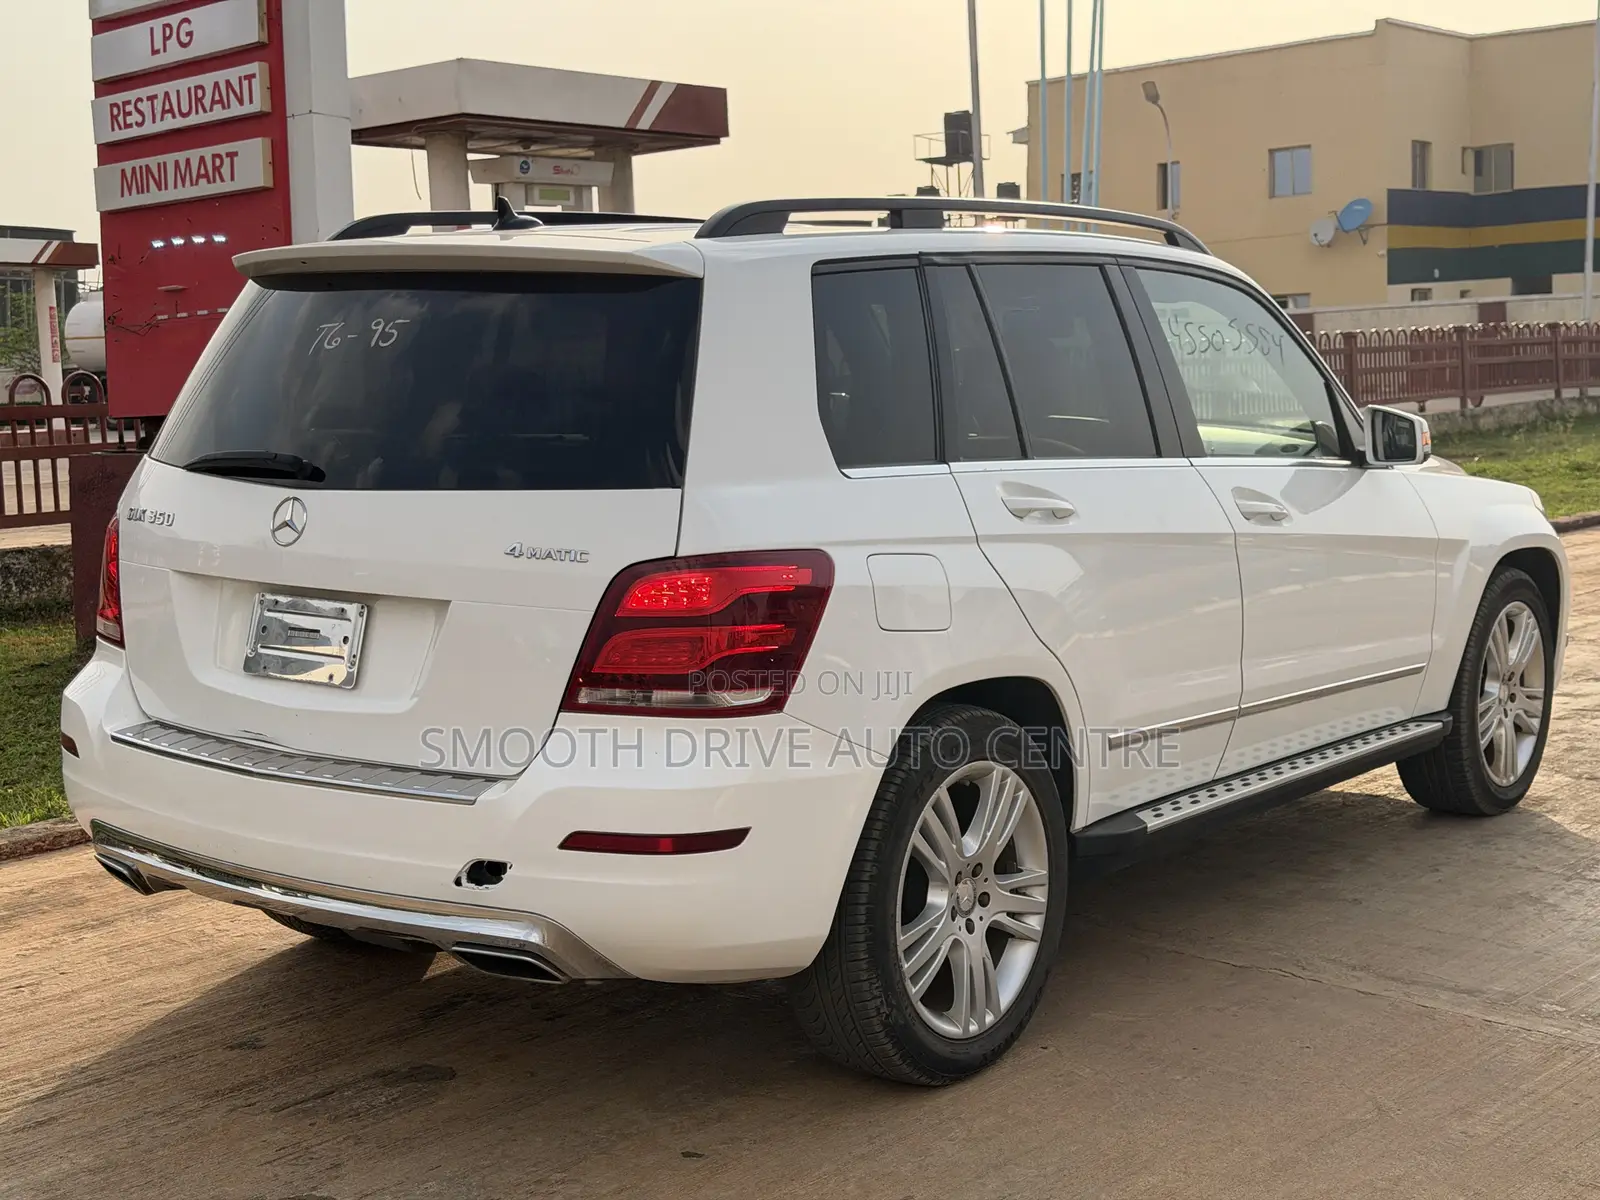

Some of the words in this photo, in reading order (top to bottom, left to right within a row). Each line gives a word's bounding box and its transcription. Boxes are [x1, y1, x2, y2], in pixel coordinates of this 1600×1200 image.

[149, 17, 194, 57] LPG
[109, 73, 257, 132] RESTAURANT
[120, 159, 169, 198] MINI
[173, 151, 239, 190] MART
[127, 507, 147, 522] GLK
[148, 510, 175, 527] 350
